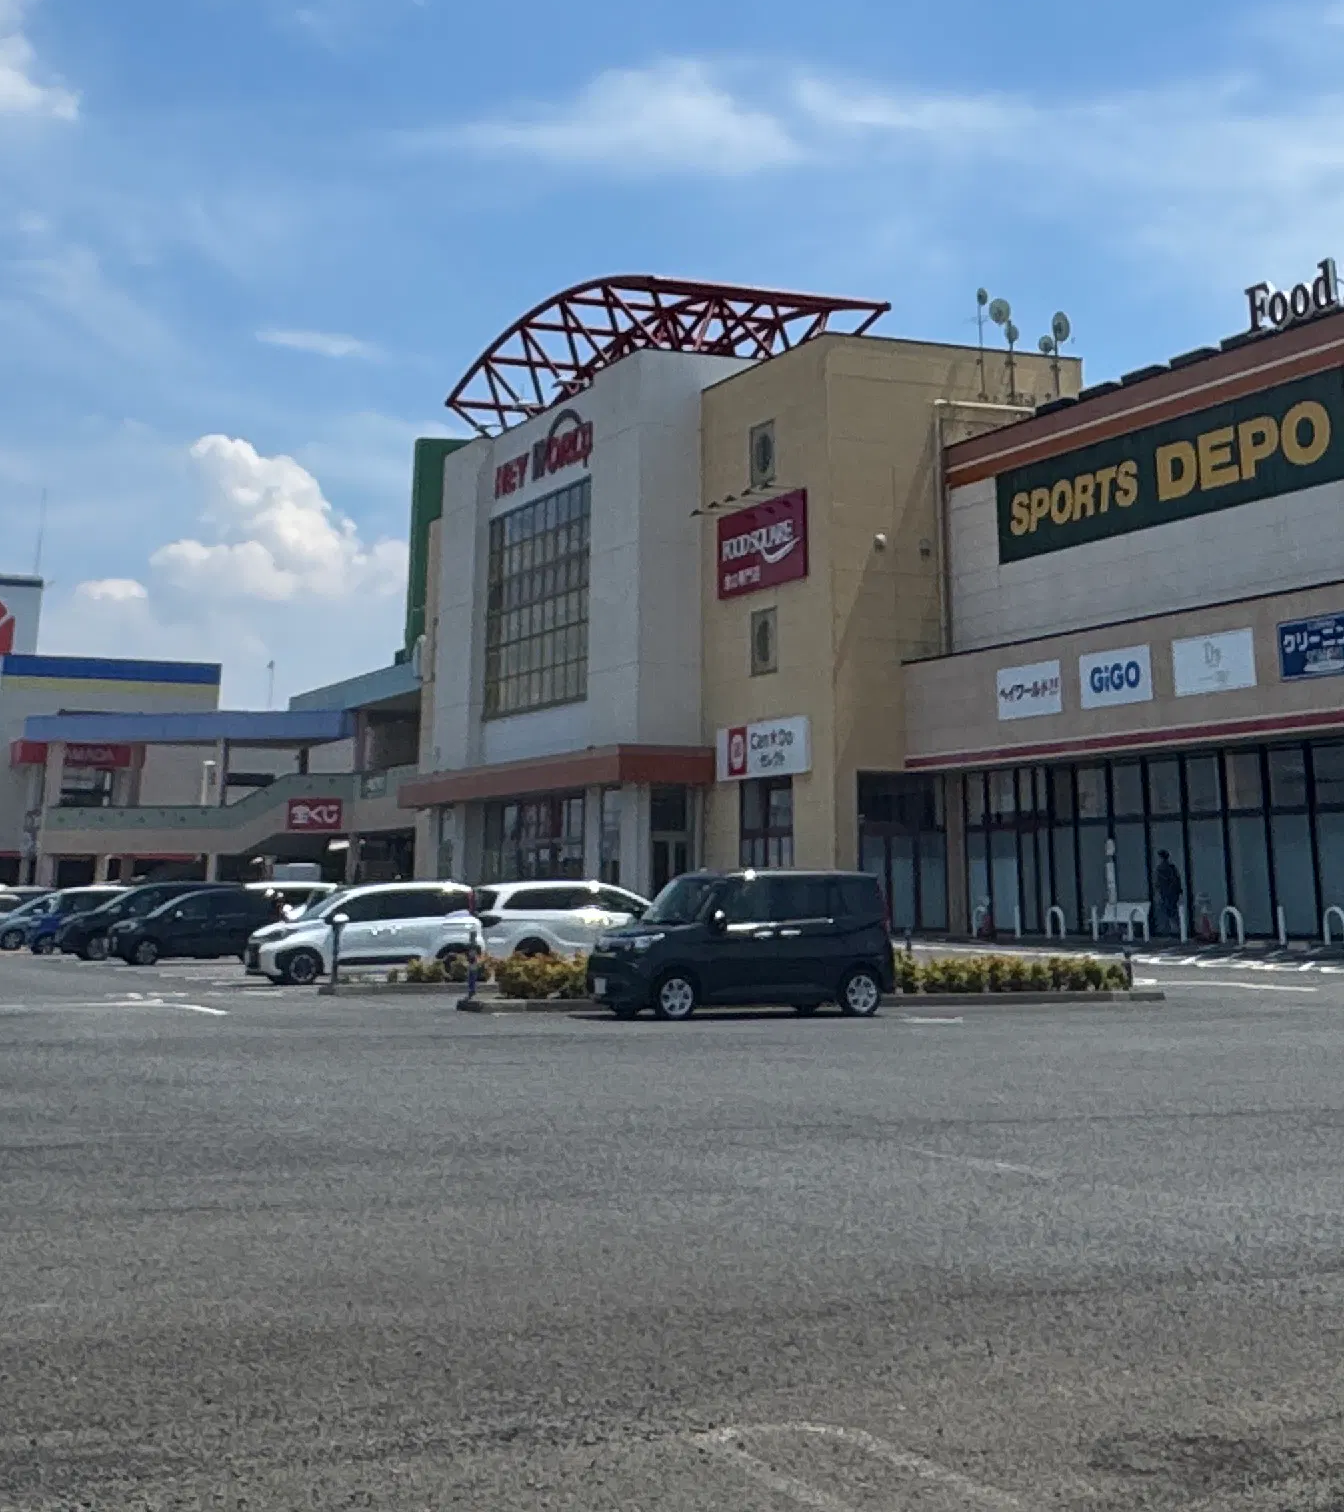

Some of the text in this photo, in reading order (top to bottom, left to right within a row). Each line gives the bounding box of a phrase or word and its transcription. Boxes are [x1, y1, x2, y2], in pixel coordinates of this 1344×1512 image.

[1244, 257, 1339, 334] Food
[495, 452, 530, 500] HEY
[1010, 401, 1331, 536] SPORTS DEPO
[1090, 660, 1140, 694] GiGO
[291, 804, 340, 824] 宝くじ
